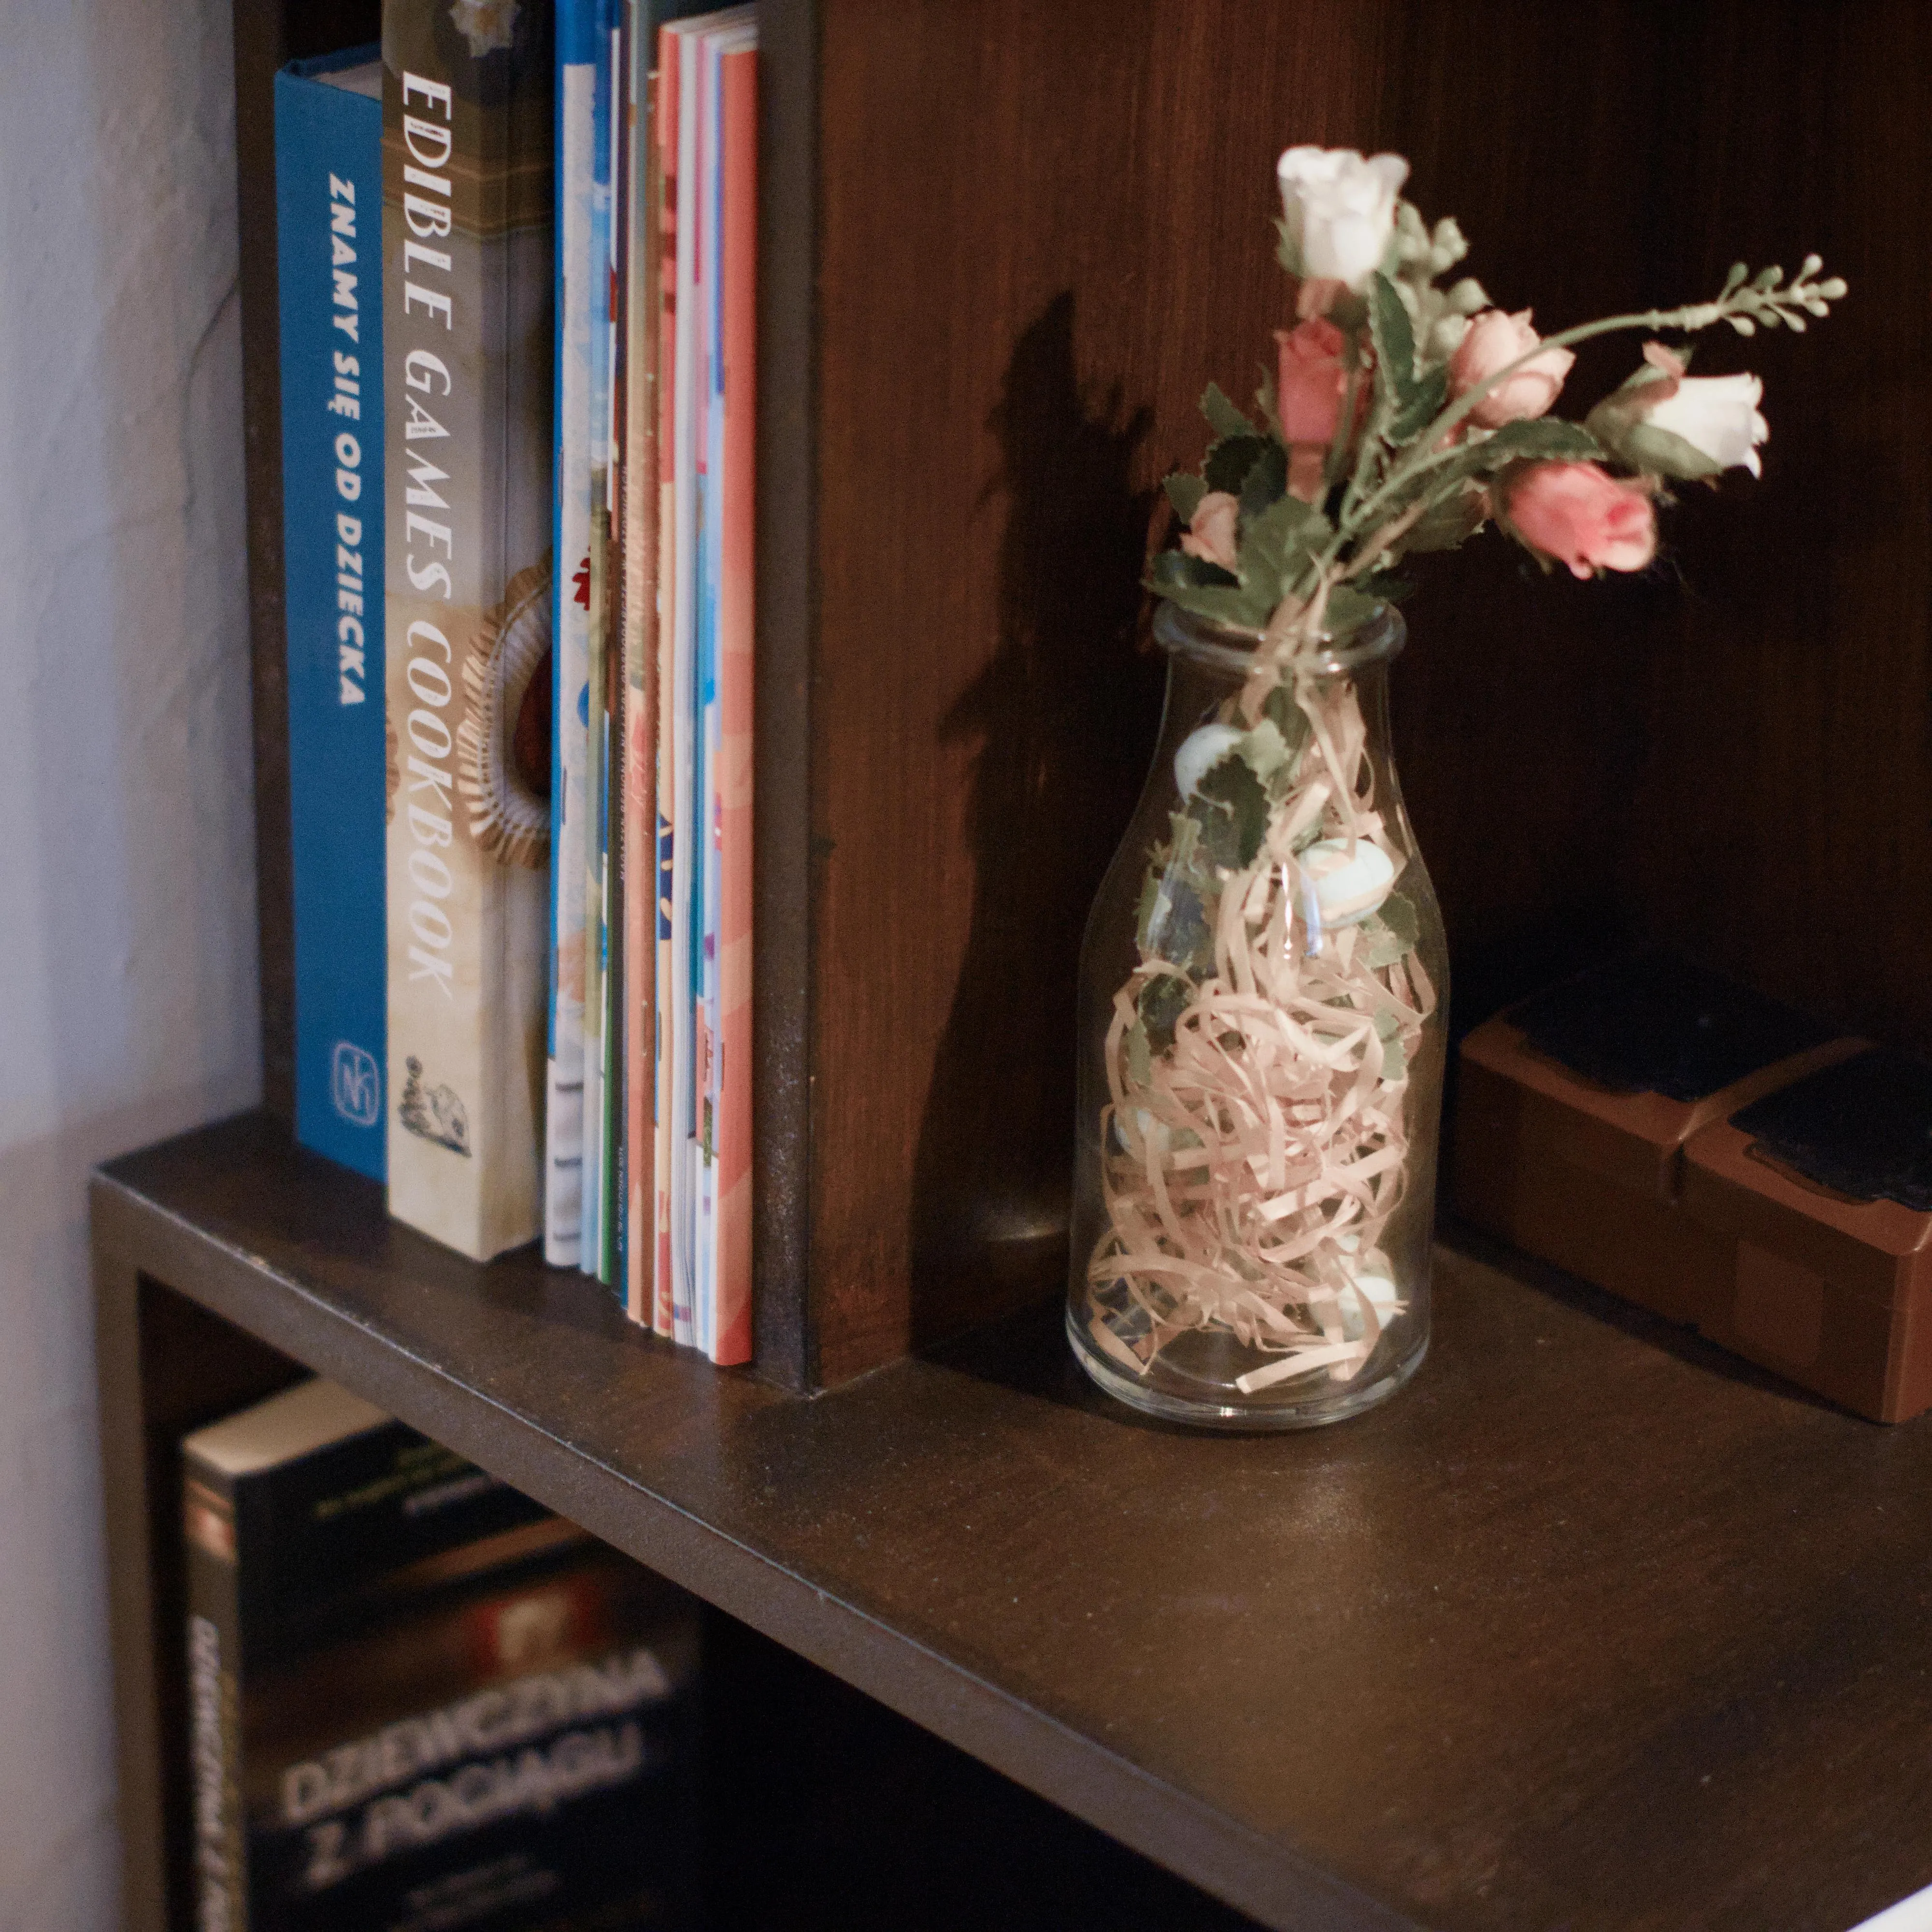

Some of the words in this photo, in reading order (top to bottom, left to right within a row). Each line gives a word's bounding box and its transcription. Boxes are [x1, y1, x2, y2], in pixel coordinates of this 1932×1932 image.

[329, 172, 359, 343] ZNAMY
[403, 71, 452, 331] EDIBLE
[328, 351, 359, 420] SIĘ
[335, 433, 361, 501] OD
[405, 350, 452, 599] GAMES
[337, 514, 365, 705] DZIECKA
[407, 620, 453, 1000] COOKBOOK
